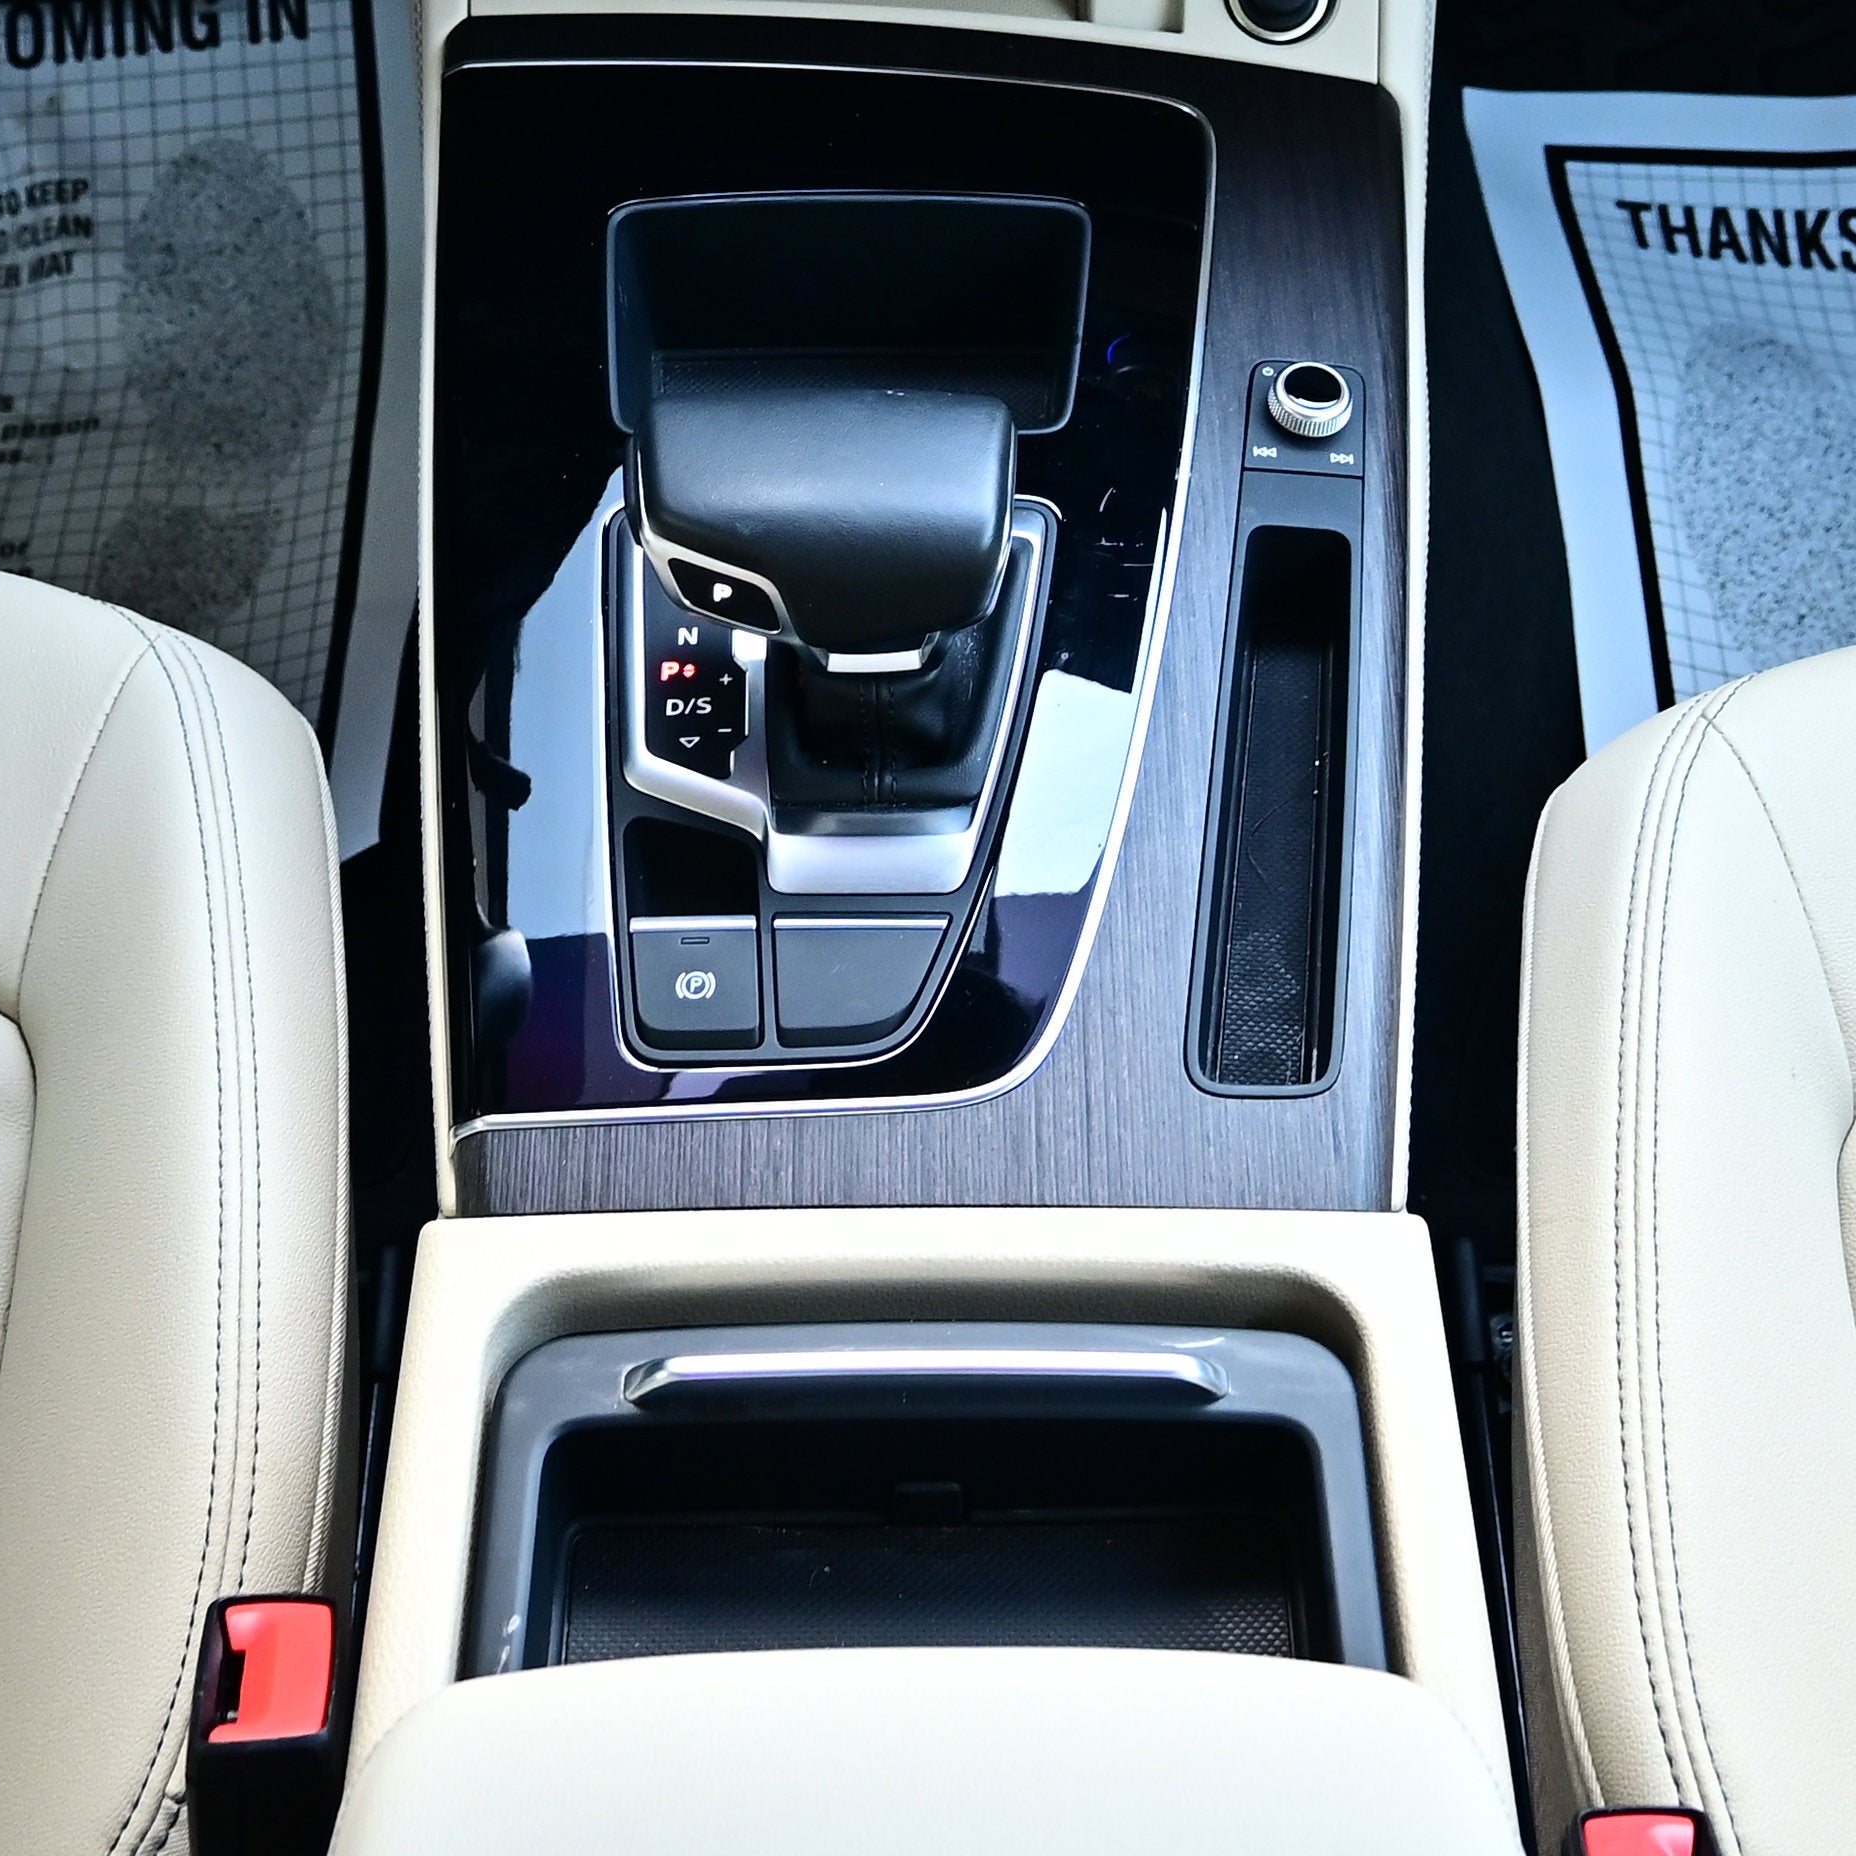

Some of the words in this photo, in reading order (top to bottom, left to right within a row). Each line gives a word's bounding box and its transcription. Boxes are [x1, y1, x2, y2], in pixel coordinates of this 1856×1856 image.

[24, 178, 89, 208] KEEP
[14, 214, 92, 249] CLEAN
[713, 582, 733, 602] P
[677, 626, 699, 646] N
[660, 661, 680, 682] P
[665, 696, 712, 716] D/S
